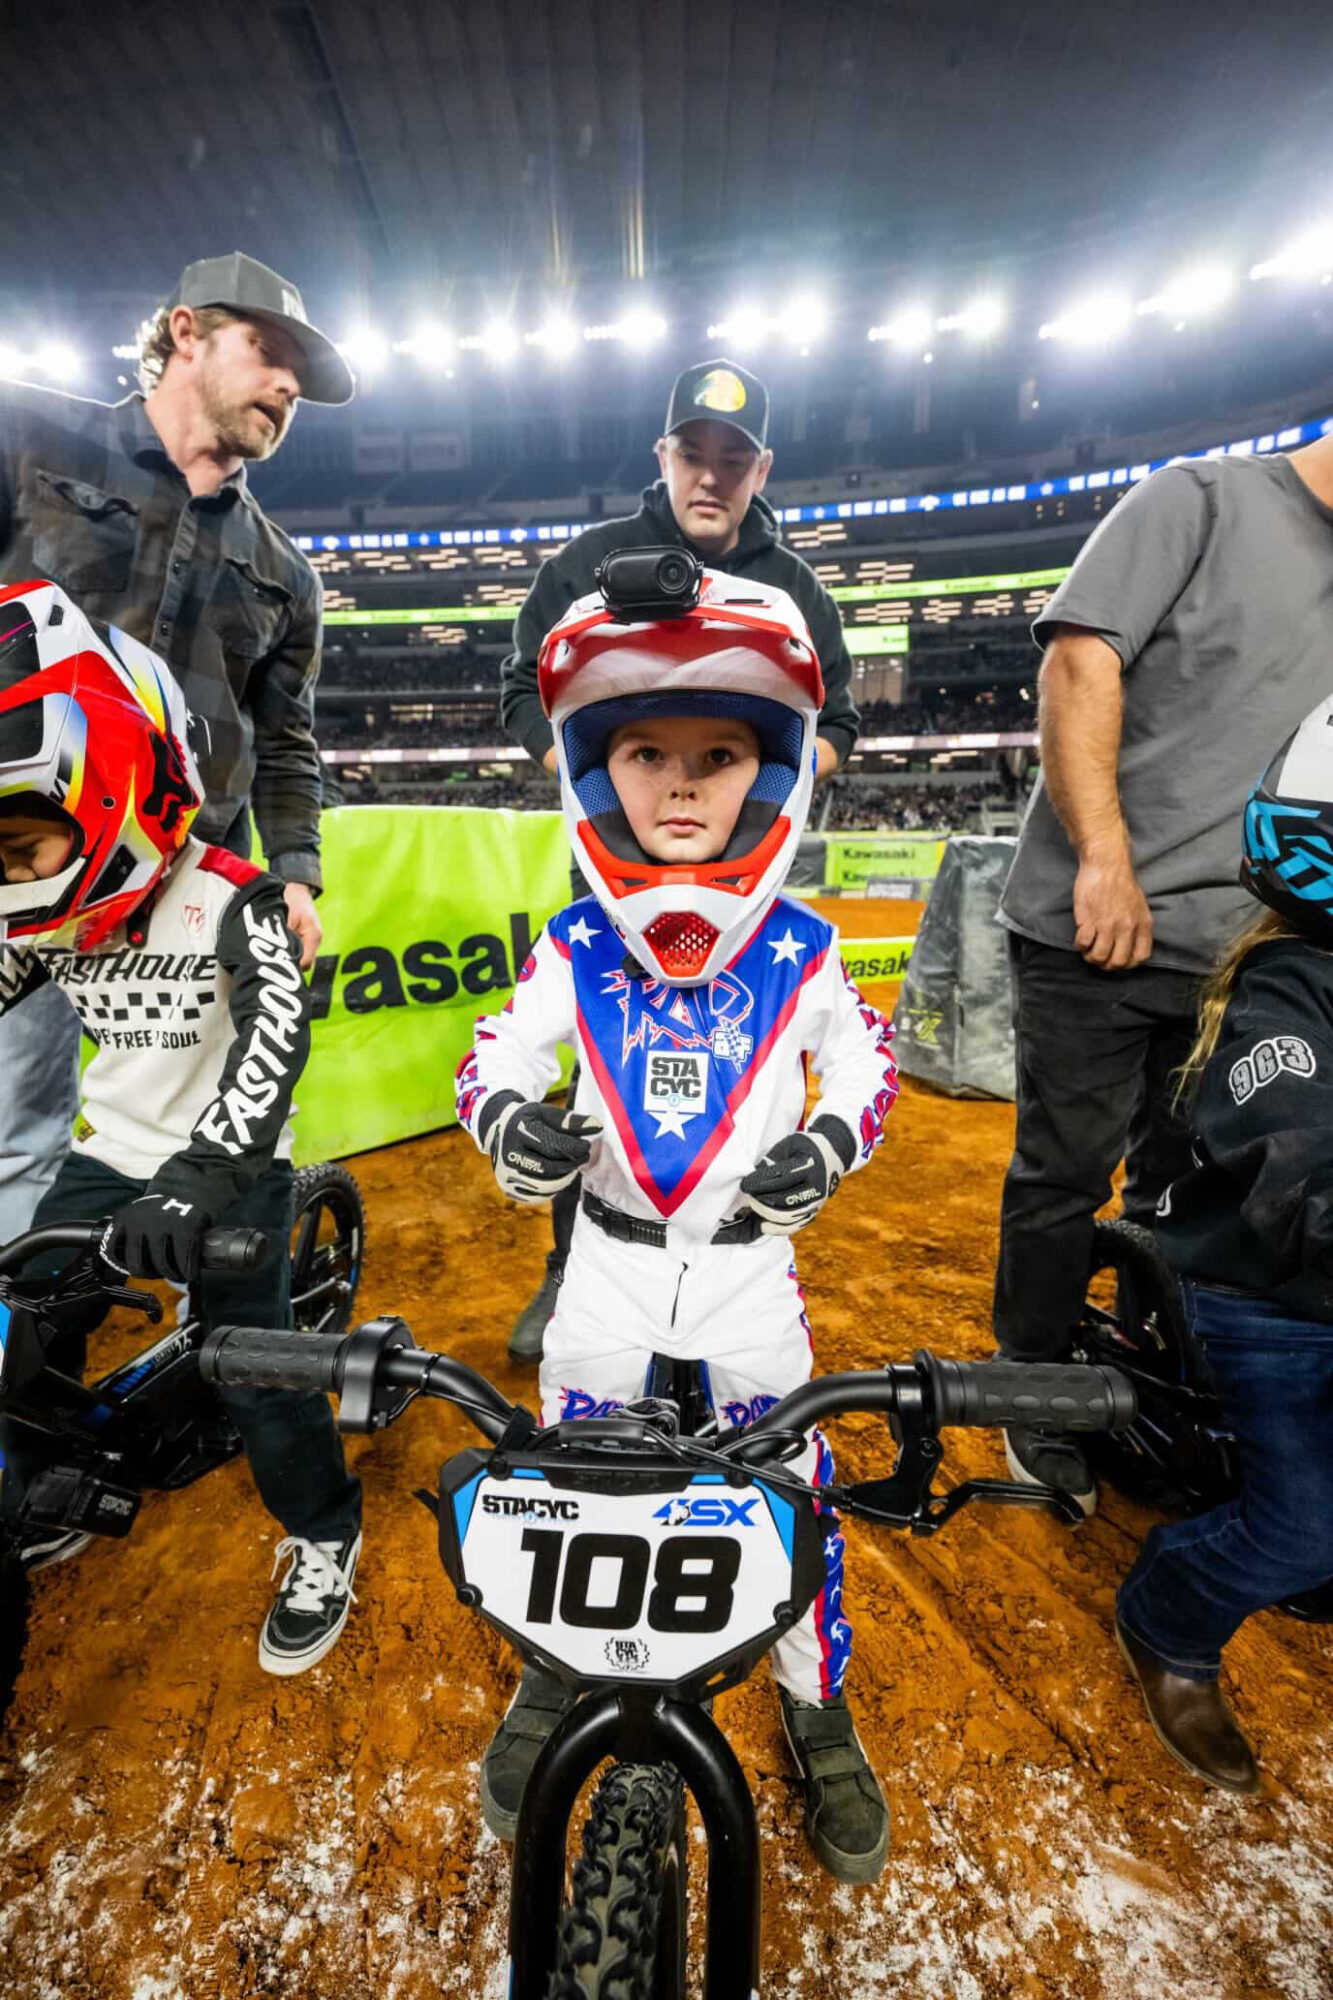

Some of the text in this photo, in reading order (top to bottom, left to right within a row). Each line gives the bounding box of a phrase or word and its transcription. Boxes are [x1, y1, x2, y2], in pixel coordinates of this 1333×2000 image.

[37, 947, 217, 985] FASTHOUE
[112, 1029, 154, 1050] FREE
[194, 903, 302, 1155] FASTHOUSE
[651, 1056, 700, 1078] STA
[650, 1077, 701, 1098] CYC
[482, 1494, 580, 1521] STACYC
[520, 1527, 742, 1634] 108
